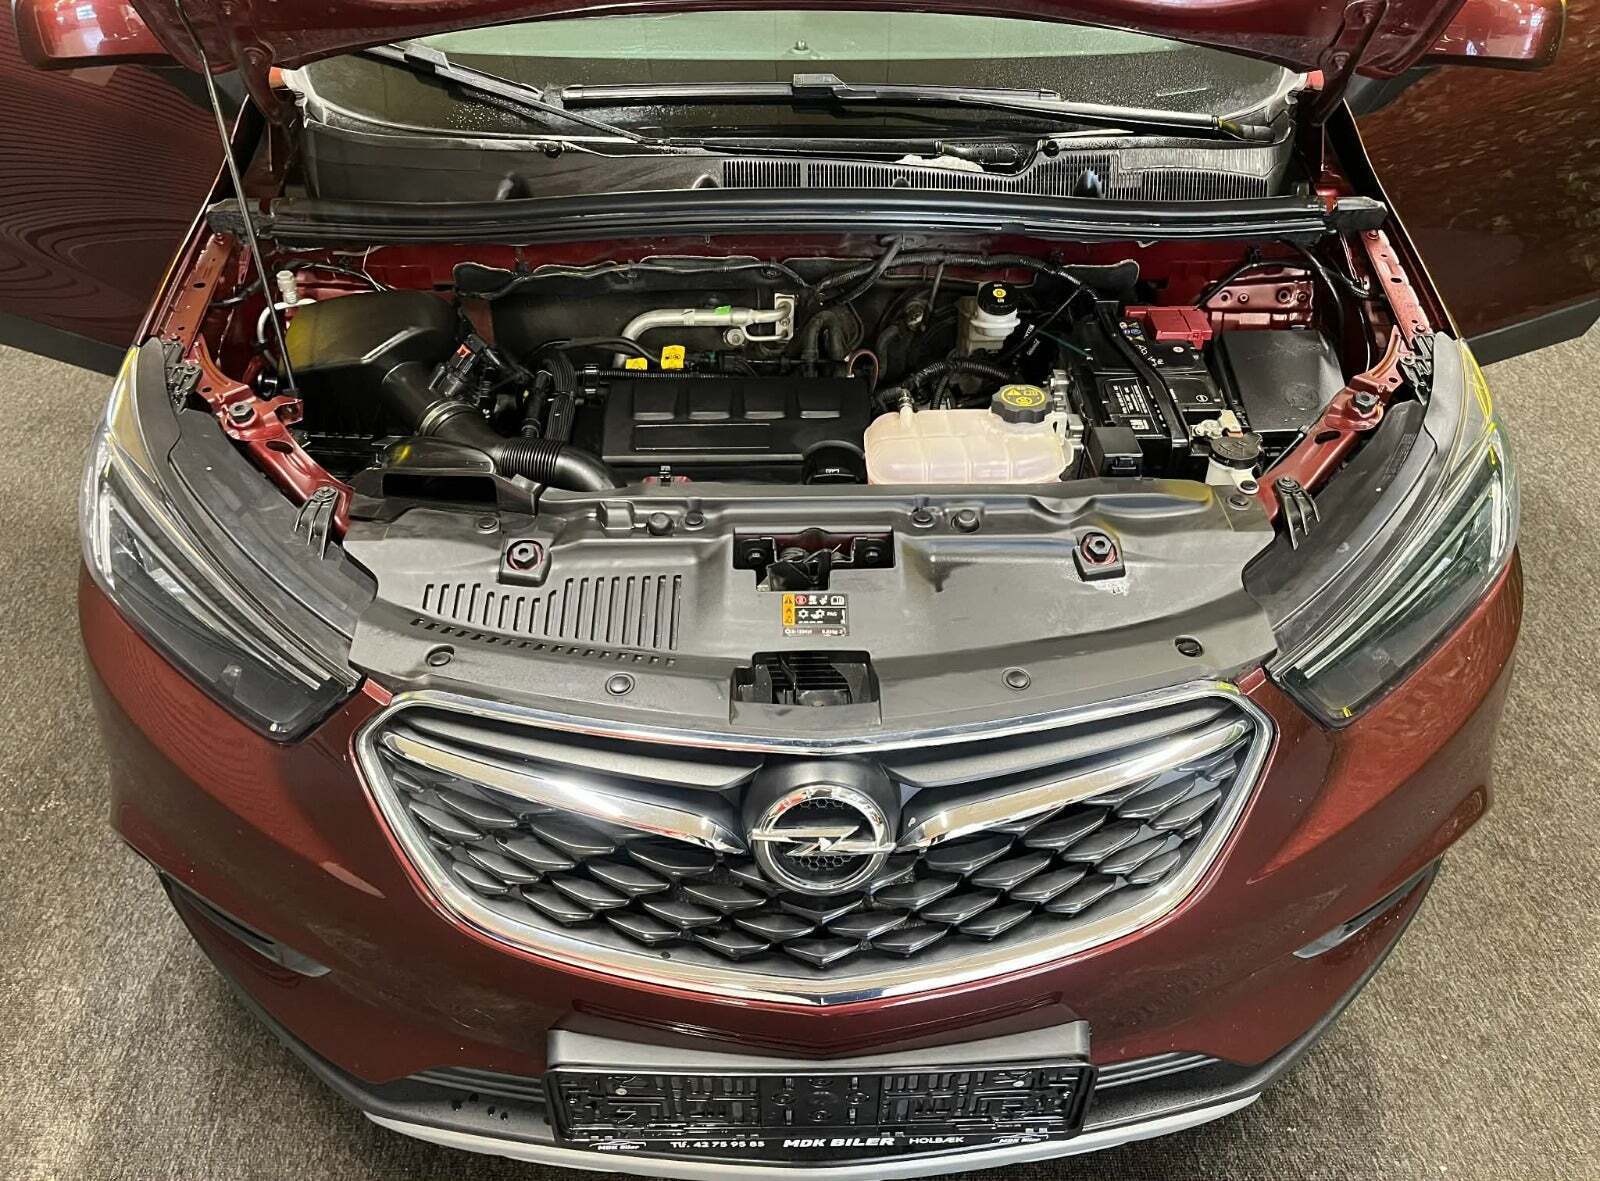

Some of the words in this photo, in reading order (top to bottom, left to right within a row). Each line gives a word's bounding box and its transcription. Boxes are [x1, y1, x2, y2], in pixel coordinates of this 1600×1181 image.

[783, 1138, 825, 1148] MDK
[830, 1137, 895, 1147] BILER
[909, 1136, 965, 1145] HOLBÆK
